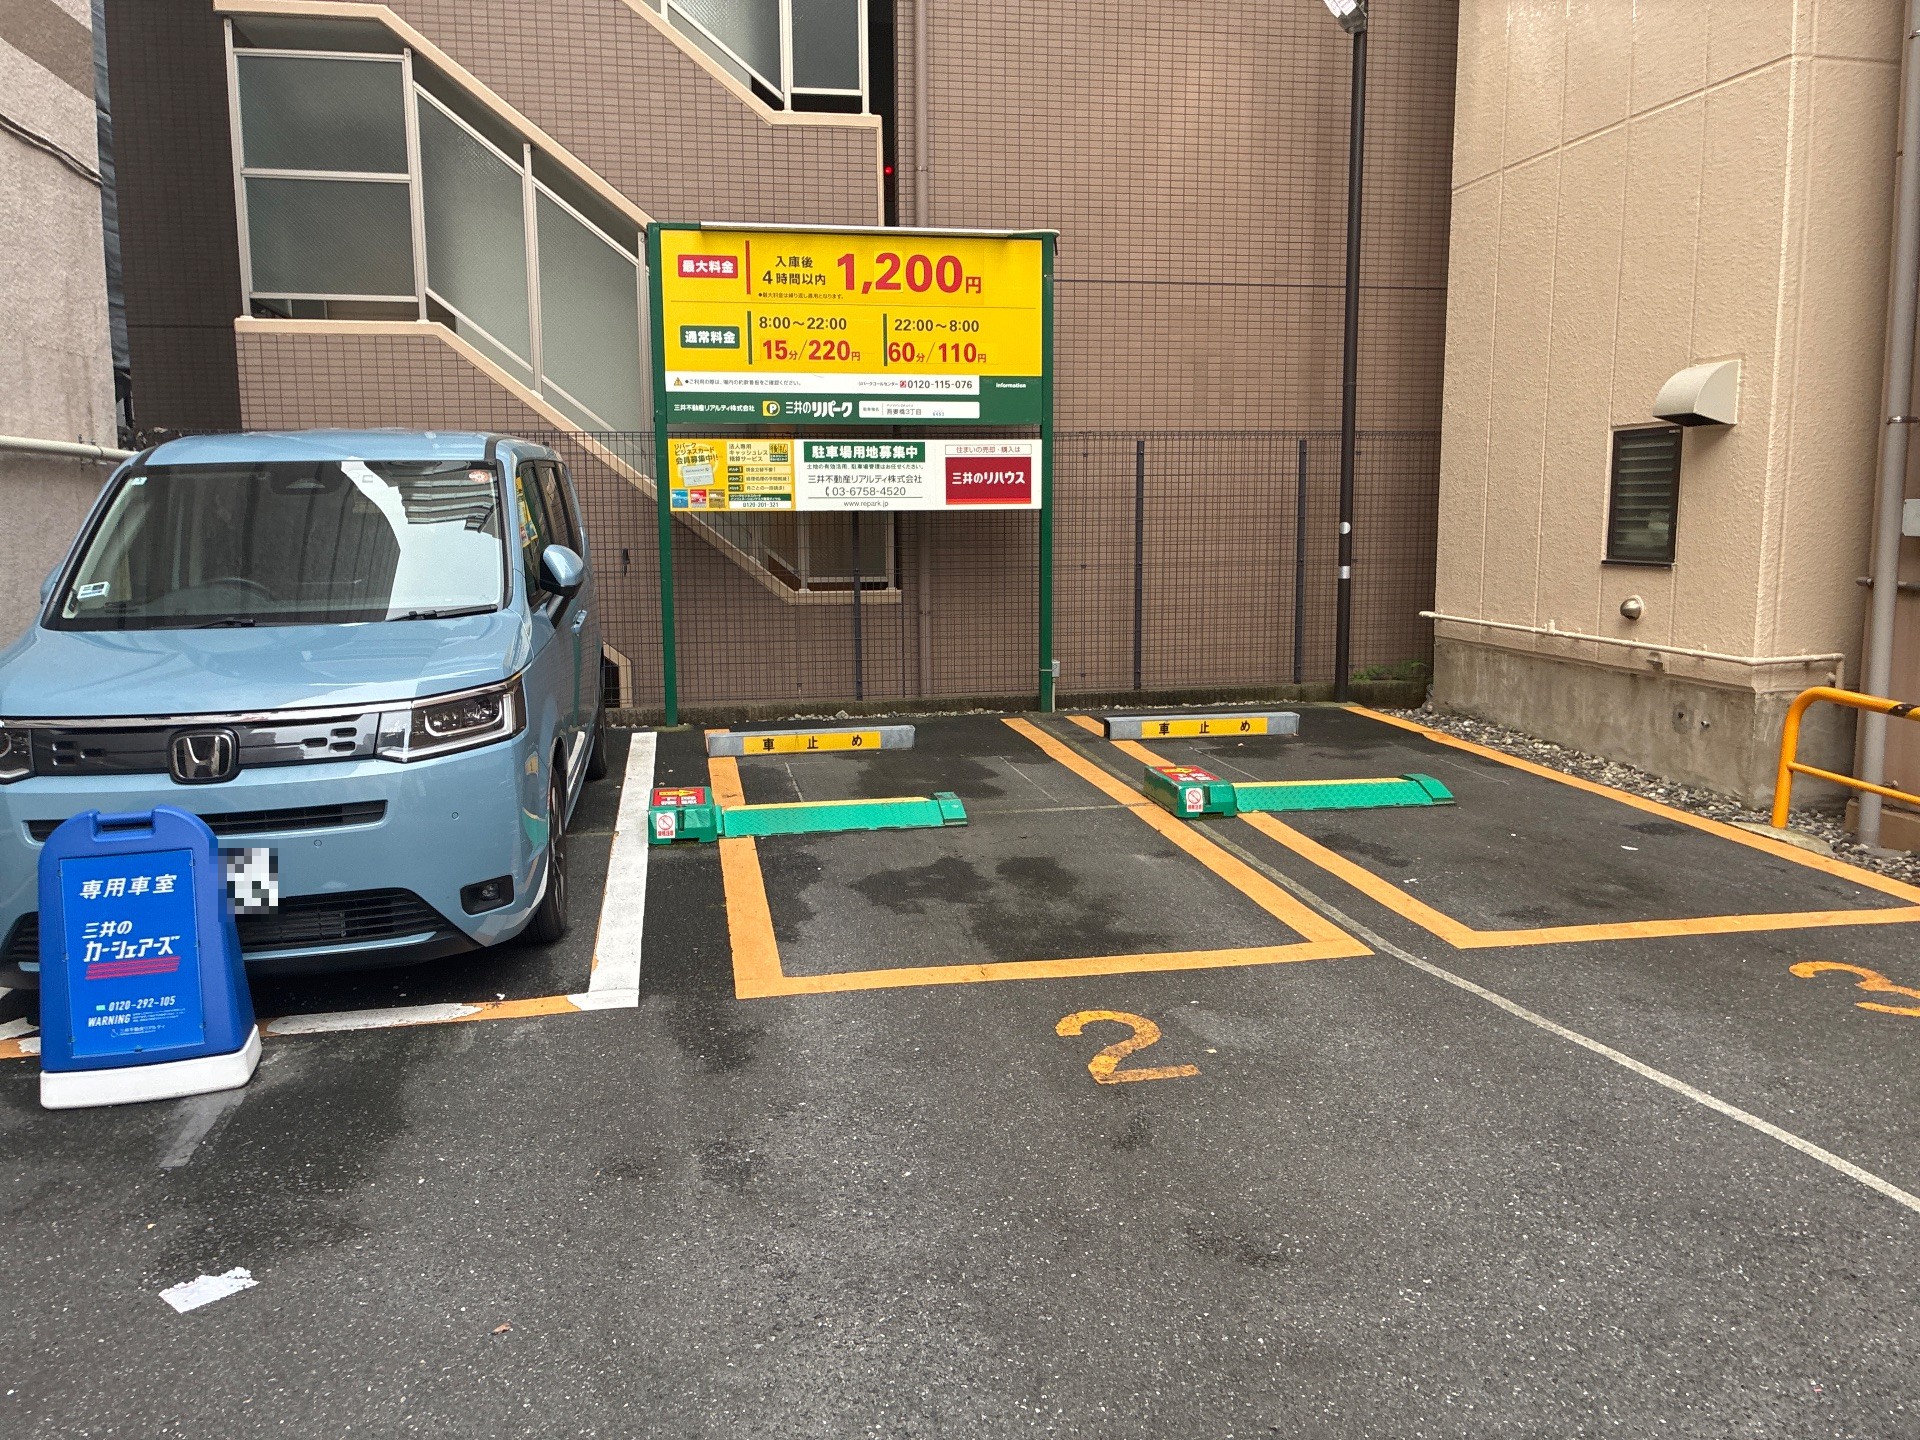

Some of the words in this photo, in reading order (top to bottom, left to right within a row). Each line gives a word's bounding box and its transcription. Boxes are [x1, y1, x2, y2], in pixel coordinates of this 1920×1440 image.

[681, 259, 735, 274] 最大料金
[775, 255, 814, 269] 入庫後
[762, 270, 827, 286] 4時間以内
[837, 252, 982, 295] 1,200円
[684, 330, 736, 345] 通常料金
[762, 339, 861, 362] 15分/220円
[888, 341, 987, 364] 60分/110円
[907, 380, 973, 390] 0120-115-076
[673, 403, 756, 413] 三井不動産リアルティ株式会社
[785, 400, 853, 419] 三井のリパーク
[811, 445, 918, 460] 駐車場用地募集中
[807, 474, 923, 485] 三井不動産リアルティ株式会社
[951, 470, 1026, 486] 三井のリハウス
[832, 486, 907, 497] 03-6758-4520
[843, 500, 889, 508] www.repark.jp
[79, 873, 178, 900] 専用車室
[82, 920, 133, 939] 三井の
[108, 995, 177, 1012] 0120-292-105
[87, 1013, 131, 1027] WARNING
[1055, 1010, 1202, 1084] 2
